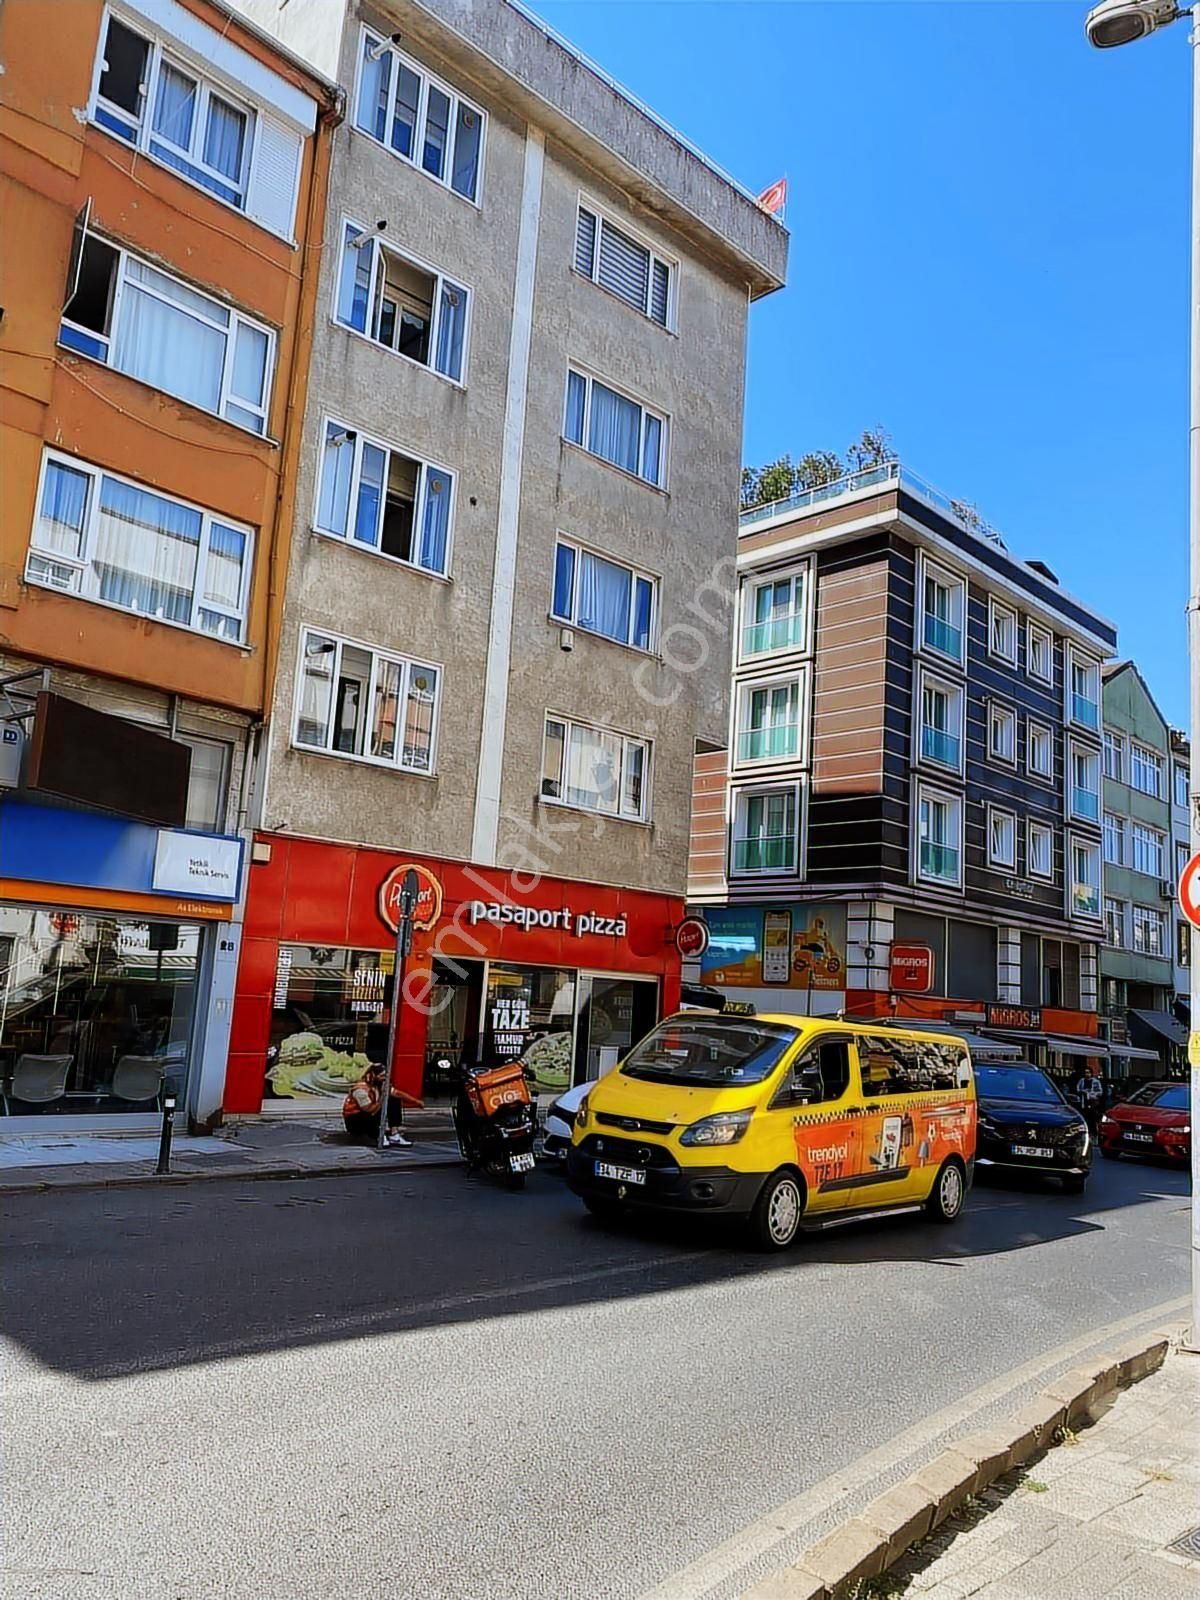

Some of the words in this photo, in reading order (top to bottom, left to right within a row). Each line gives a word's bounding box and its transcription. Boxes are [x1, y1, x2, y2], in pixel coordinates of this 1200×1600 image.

[471, 900, 572, 932] pasaport
[576, 911, 627, 938] pizza
[491, 1009, 531, 1030] TAZE
[808, 1142, 848, 1163] trendyol
